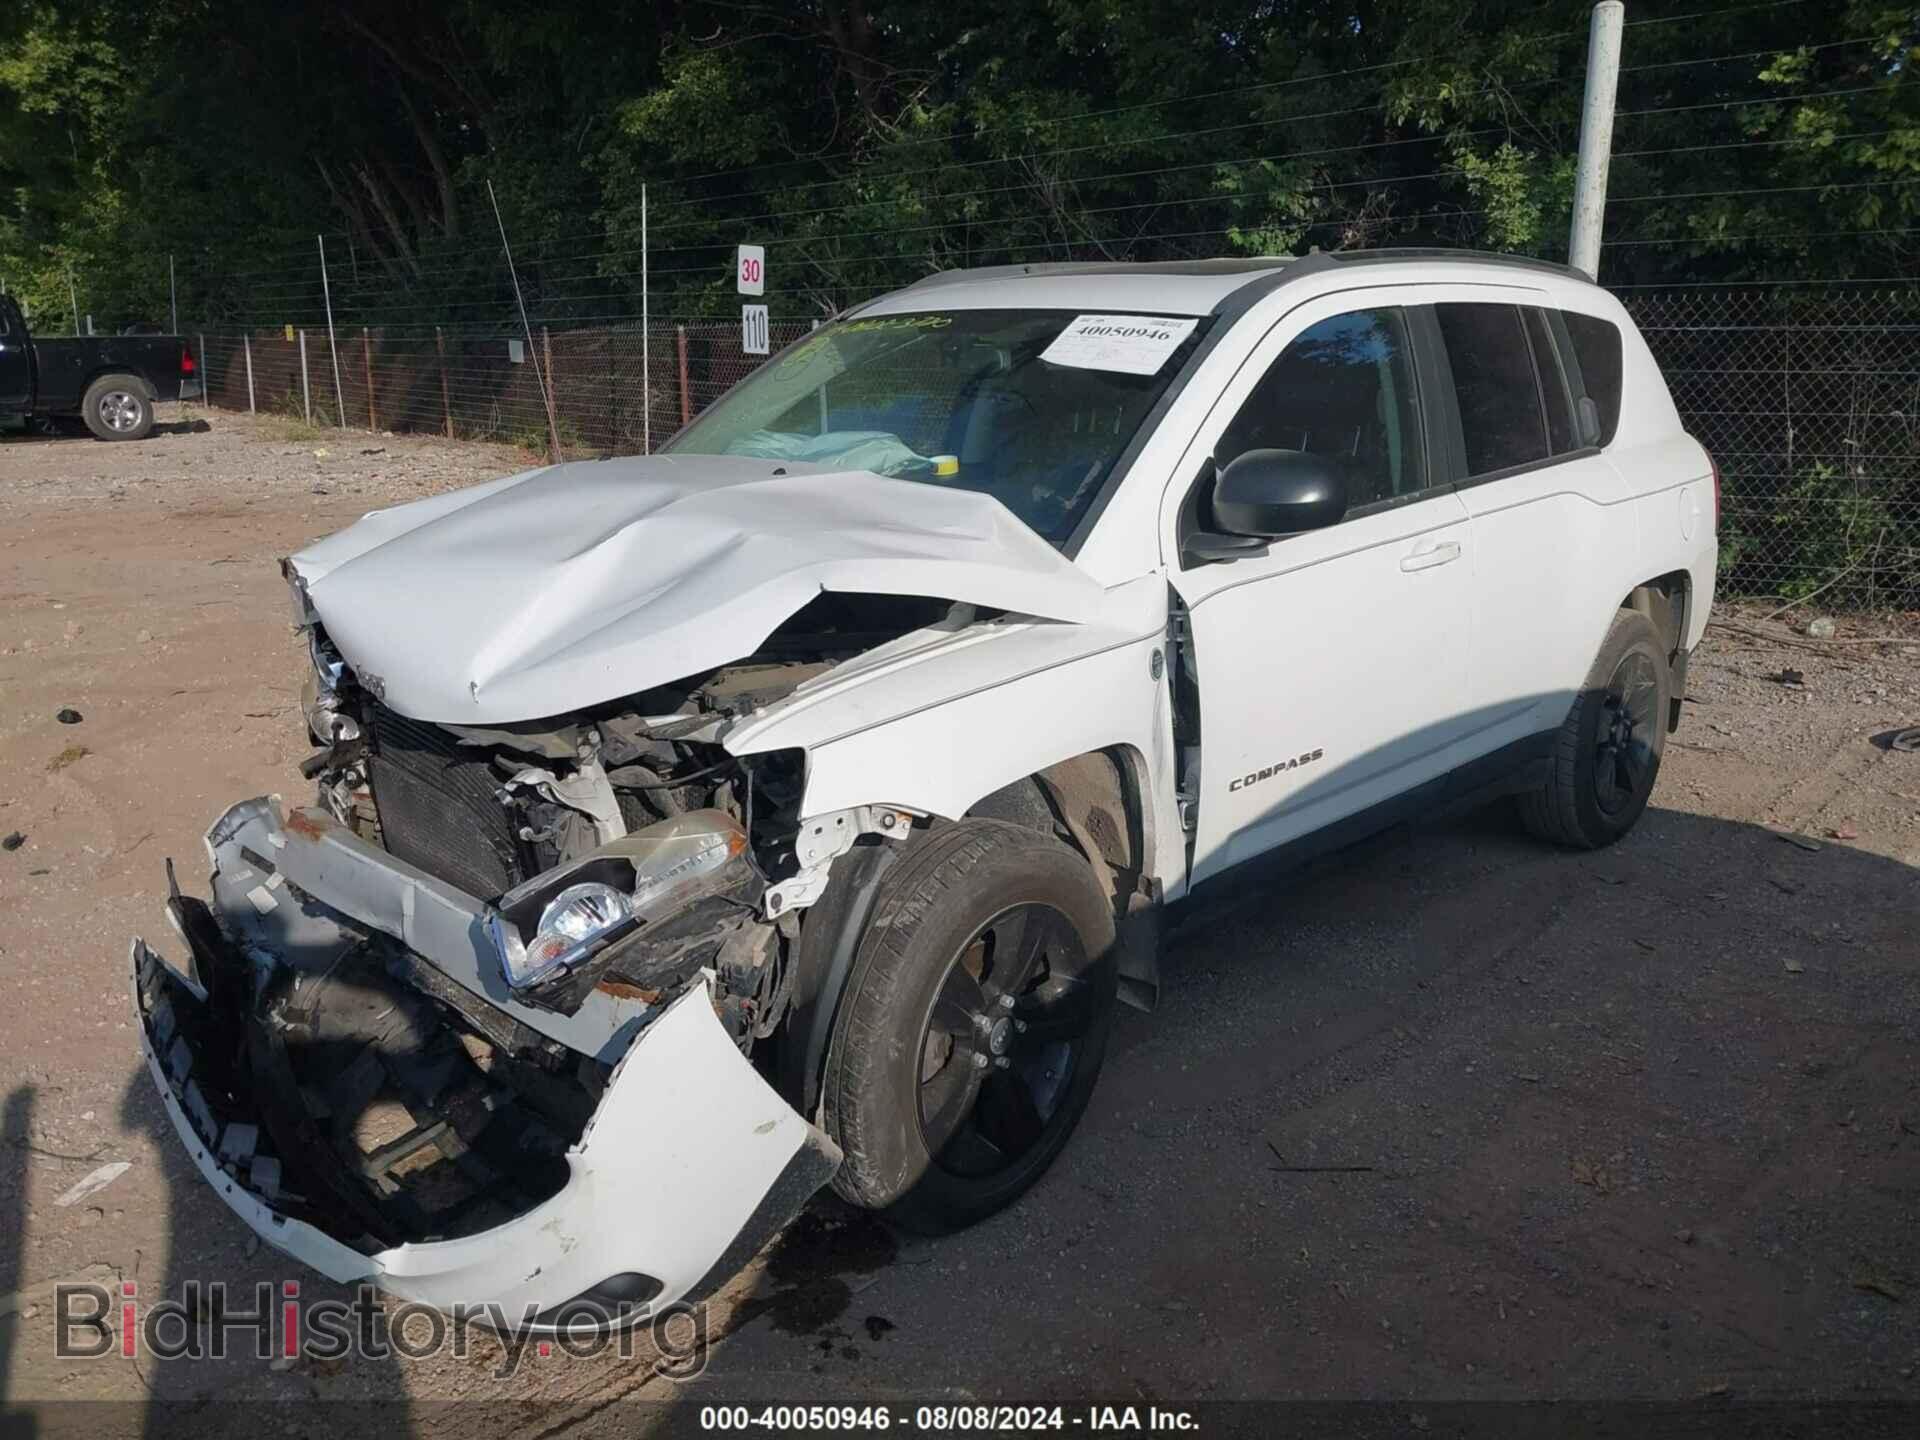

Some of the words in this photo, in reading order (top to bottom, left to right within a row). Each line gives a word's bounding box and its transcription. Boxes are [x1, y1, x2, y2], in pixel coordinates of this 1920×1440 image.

[742, 259, 760, 282] 30
[746, 310, 765, 349] 110
[1077, 325, 1170, 341] 40050946
[1229, 747, 1323, 792] COMPASS
